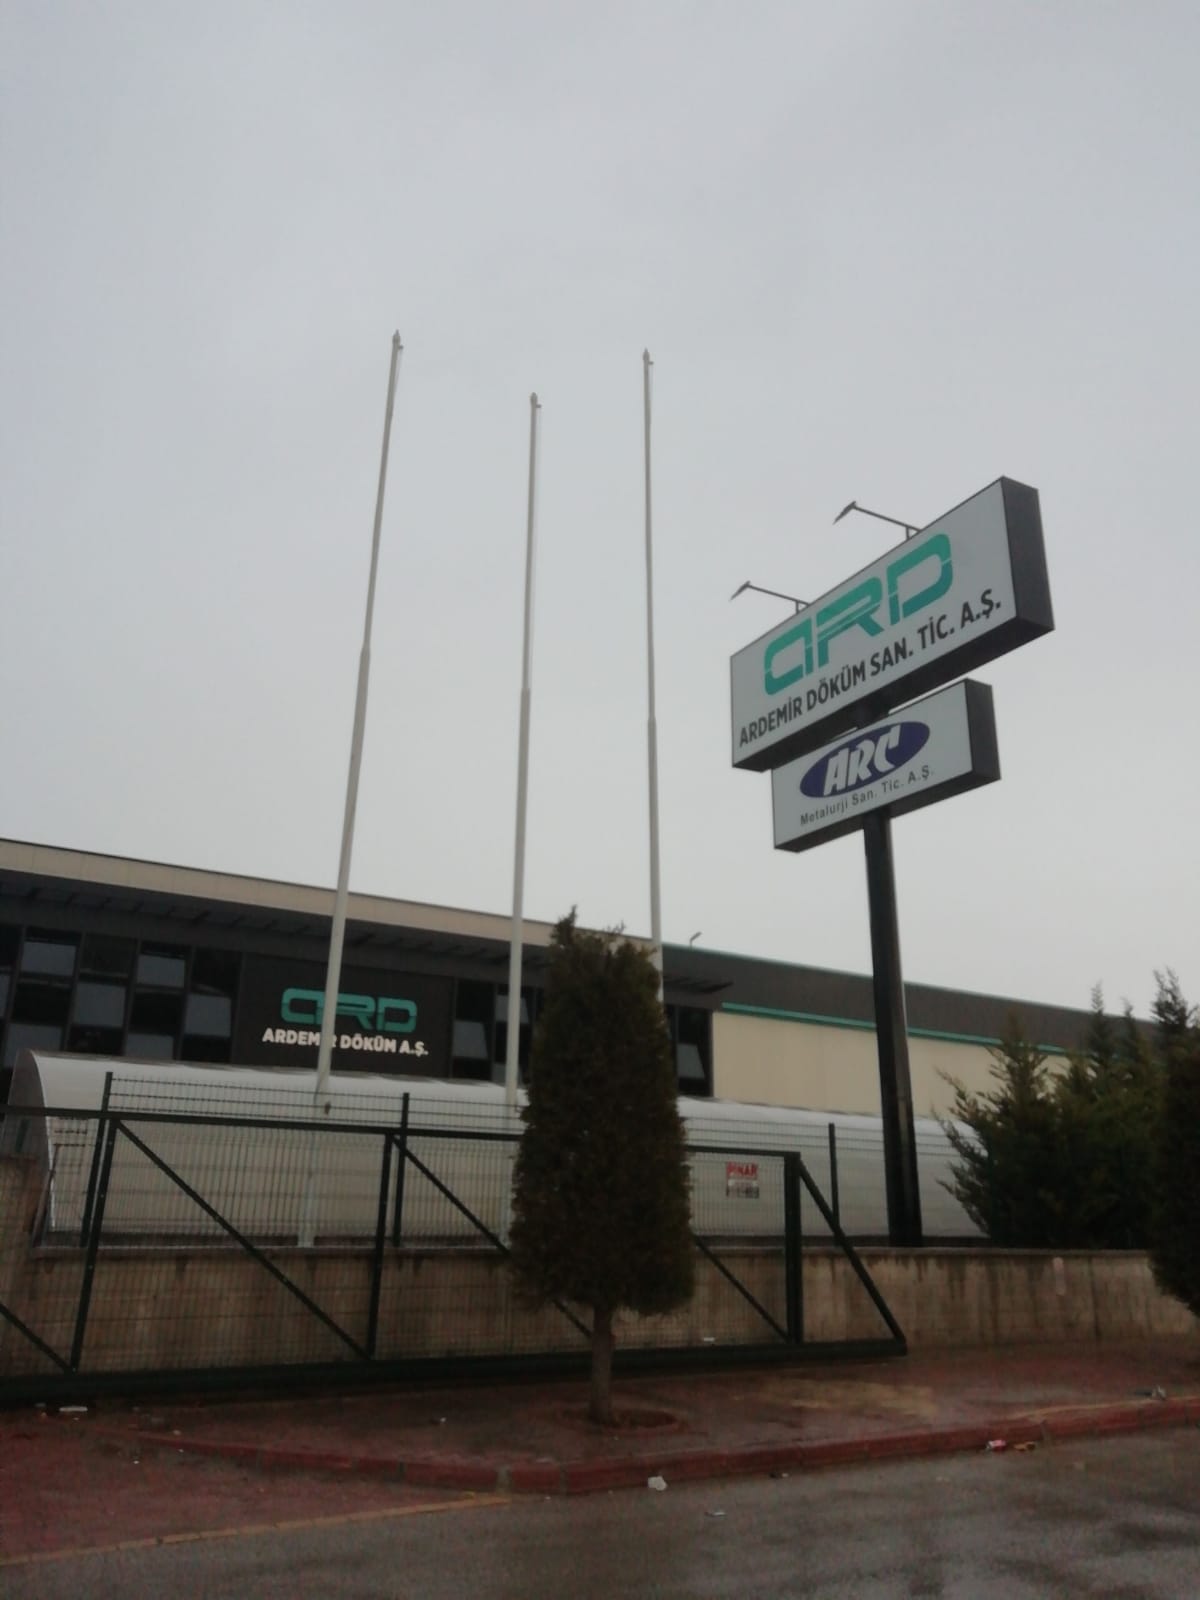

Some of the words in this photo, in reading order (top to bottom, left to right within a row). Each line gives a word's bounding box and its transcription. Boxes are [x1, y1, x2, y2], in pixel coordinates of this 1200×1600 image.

[739, 697, 803, 747] ARDEMİR
[807, 661, 866, 712] DÖKÜM
[870, 637, 913, 677] SAN.
[917, 613, 955, 651] TİC.
[960, 588, 1002, 630] A.Ş.
[823, 724, 901, 796] ARC
[800, 799, 848, 825] Metalurji
[852, 788, 877, 806] San.
[881, 781, 905, 793] Tic.
[908, 765, 934, 780] A.Ş.
[340, 1033, 397, 1053] DÖKÜM
[399, 1041, 429, 1057] A.Ş.
